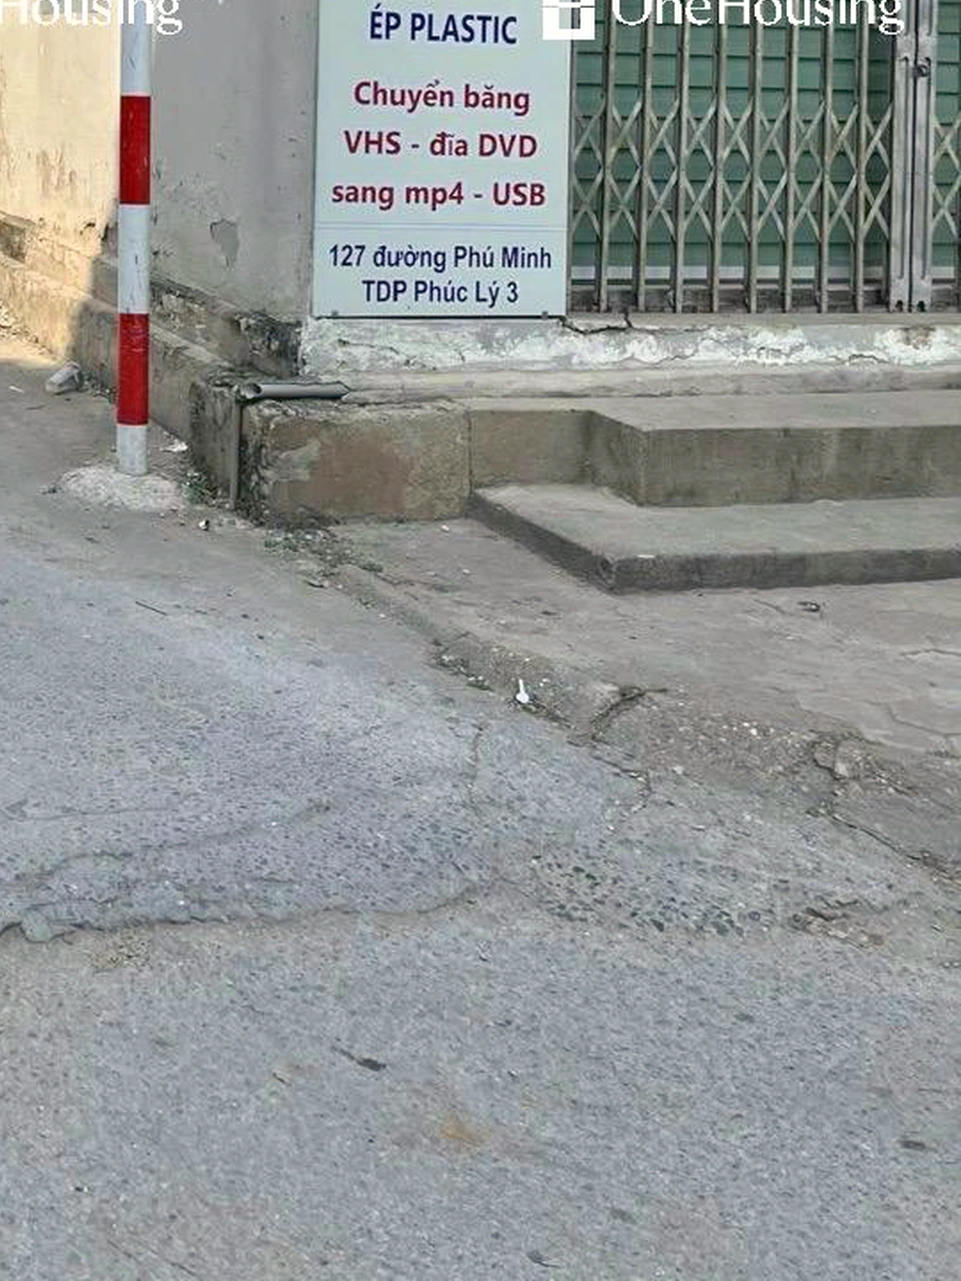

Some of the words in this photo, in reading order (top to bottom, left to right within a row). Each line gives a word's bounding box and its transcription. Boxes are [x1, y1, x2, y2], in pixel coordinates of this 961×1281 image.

[369, 3, 401, 40] ÉP
[410, 13, 518, 45] PLASTIC
[354, 79, 454, 114] Chuyển
[464, 85, 530, 116] băng
[344, 131, 401, 155] VHS
[429, 131, 468, 157] đĩa
[478, 134, 537, 158] DVD
[332, 183, 394, 211] sang
[405, 182, 464, 211] mp4
[492, 182, 546, 207] USB
[329, 244, 366, 267] 127
[373, 244, 446, 273] đường
[453, 246, 494, 269] Phú
[501, 246, 552, 269] Minh
[362, 279, 407, 303] TDP
[414, 280, 468, 303] Phúc
[475, 280, 500, 309] Lý
[507, 281, 519, 304] 3
